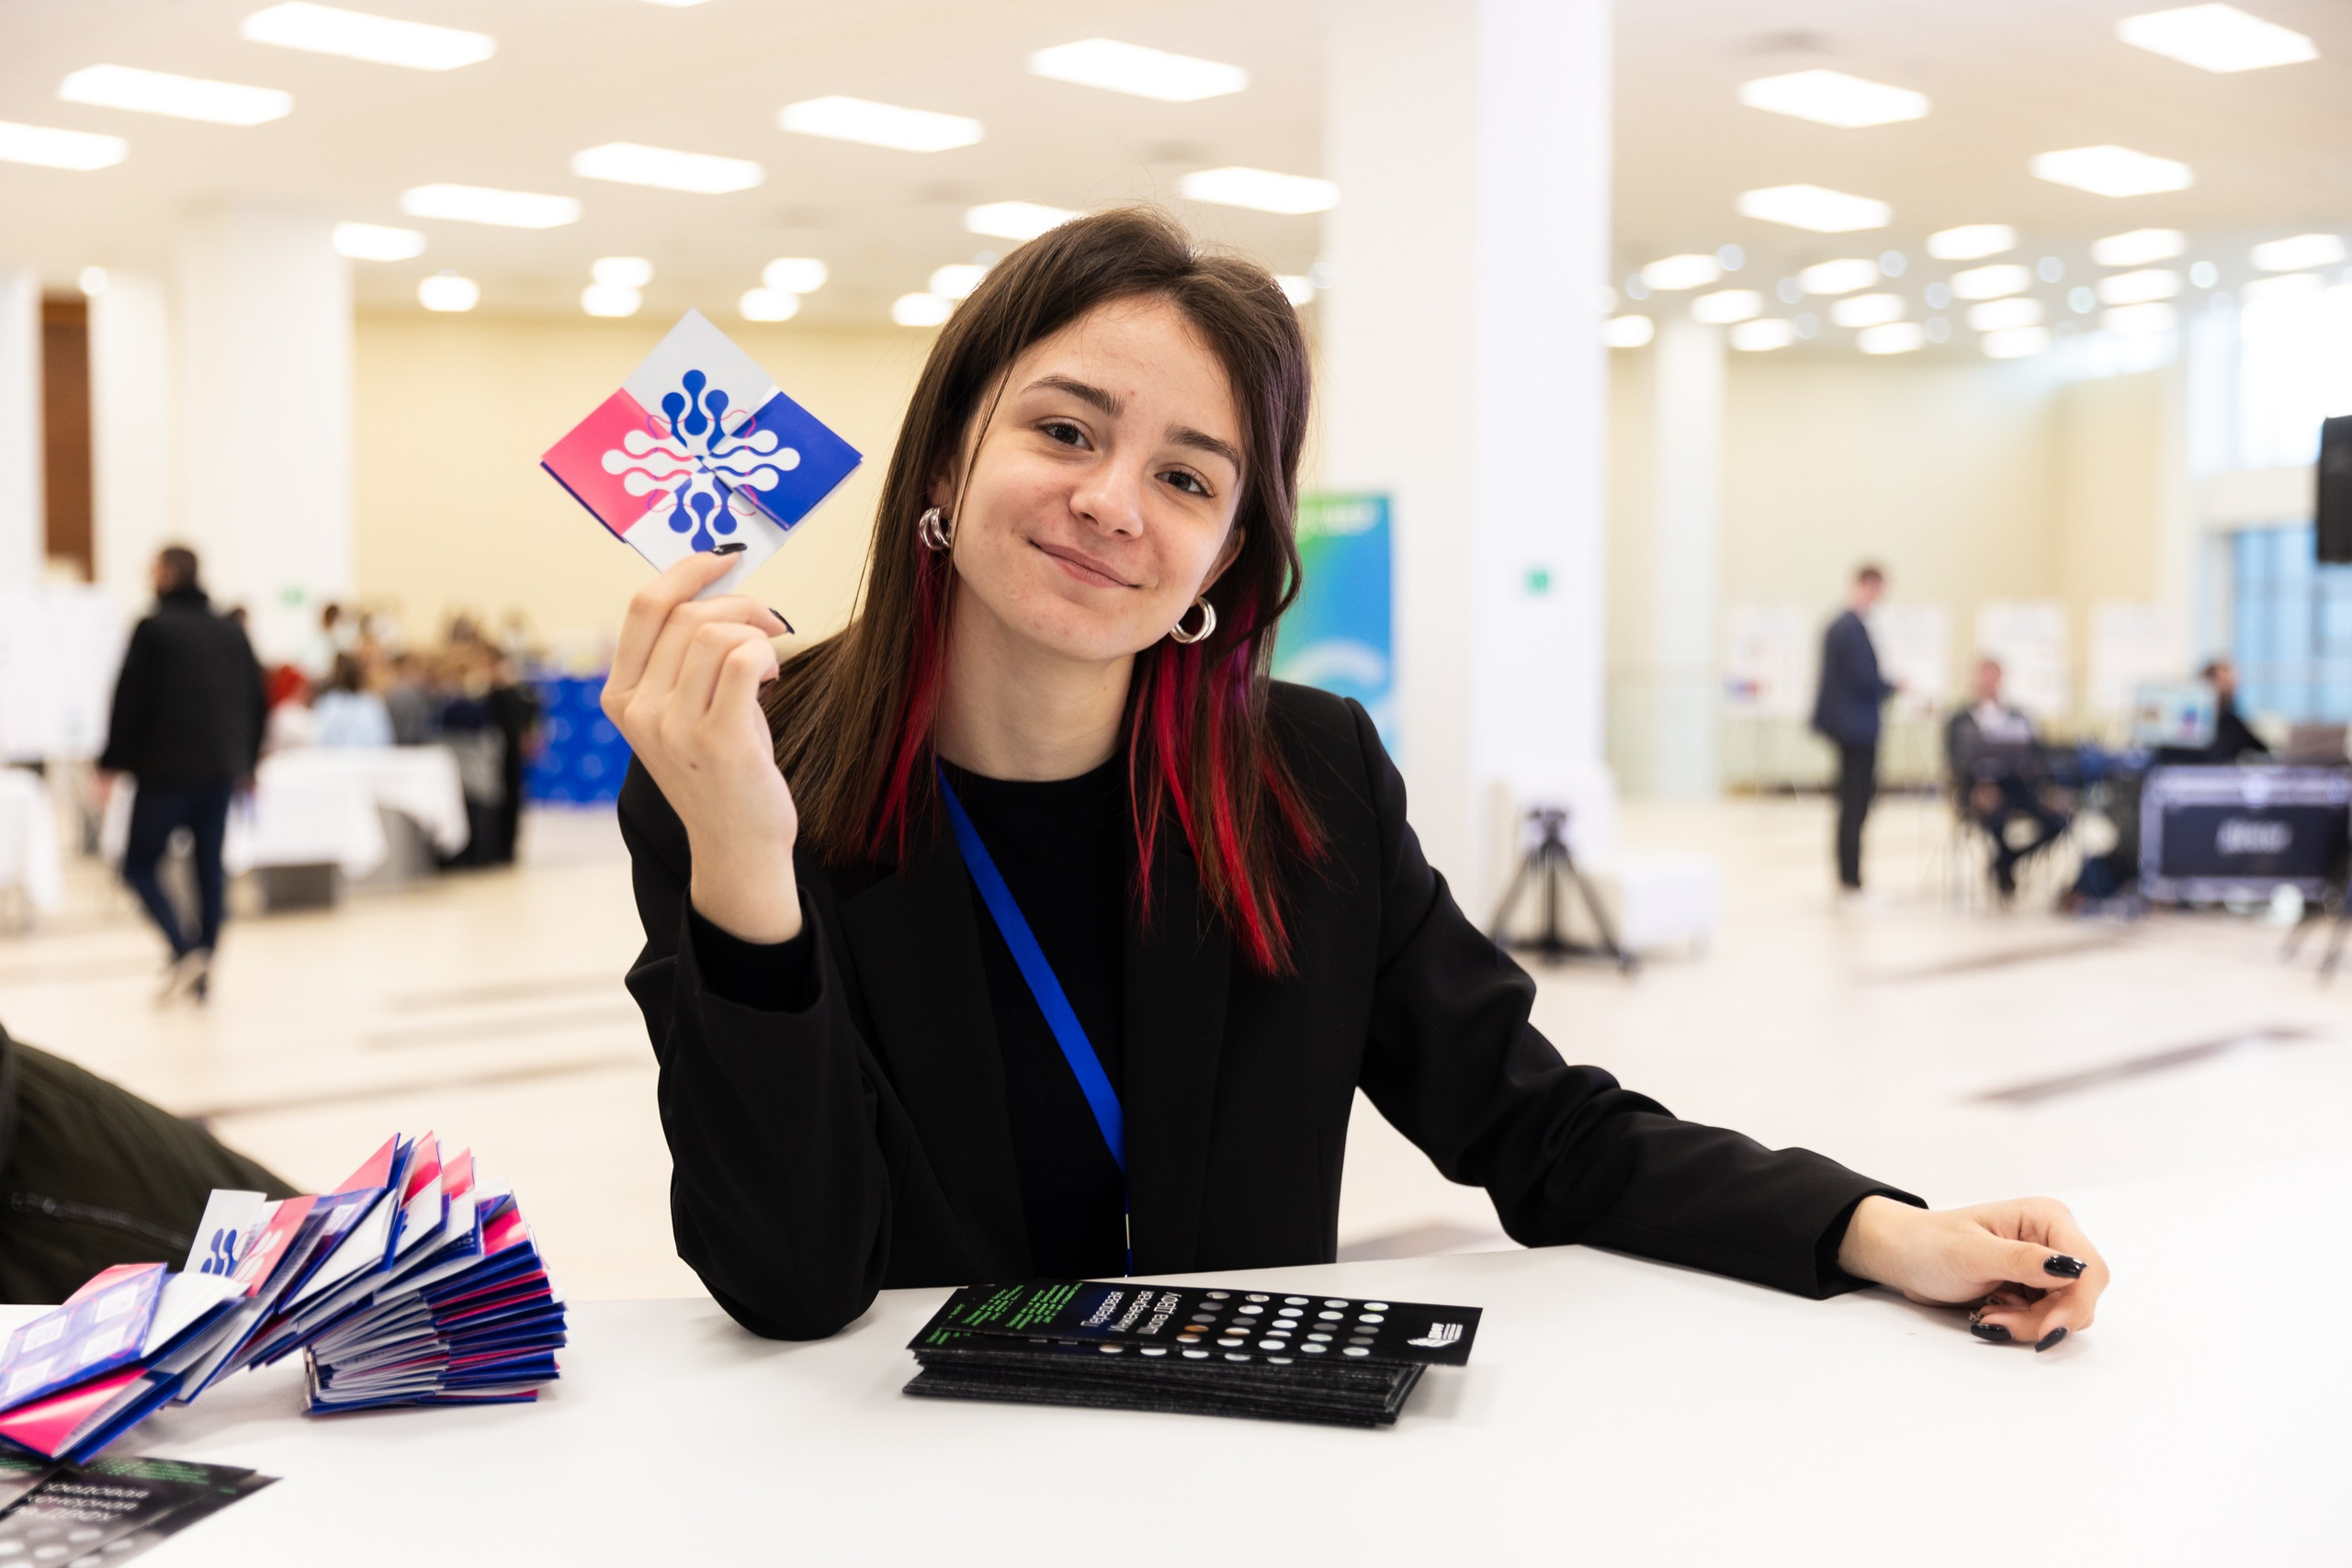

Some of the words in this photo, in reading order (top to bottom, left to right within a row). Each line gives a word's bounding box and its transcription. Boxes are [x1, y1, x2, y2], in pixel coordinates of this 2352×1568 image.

[1080, 1291, 1125, 1327] Передовая
[1107, 1291, 1155, 1332] Инженерная
[43, 1482, 151, 1499] редовая
